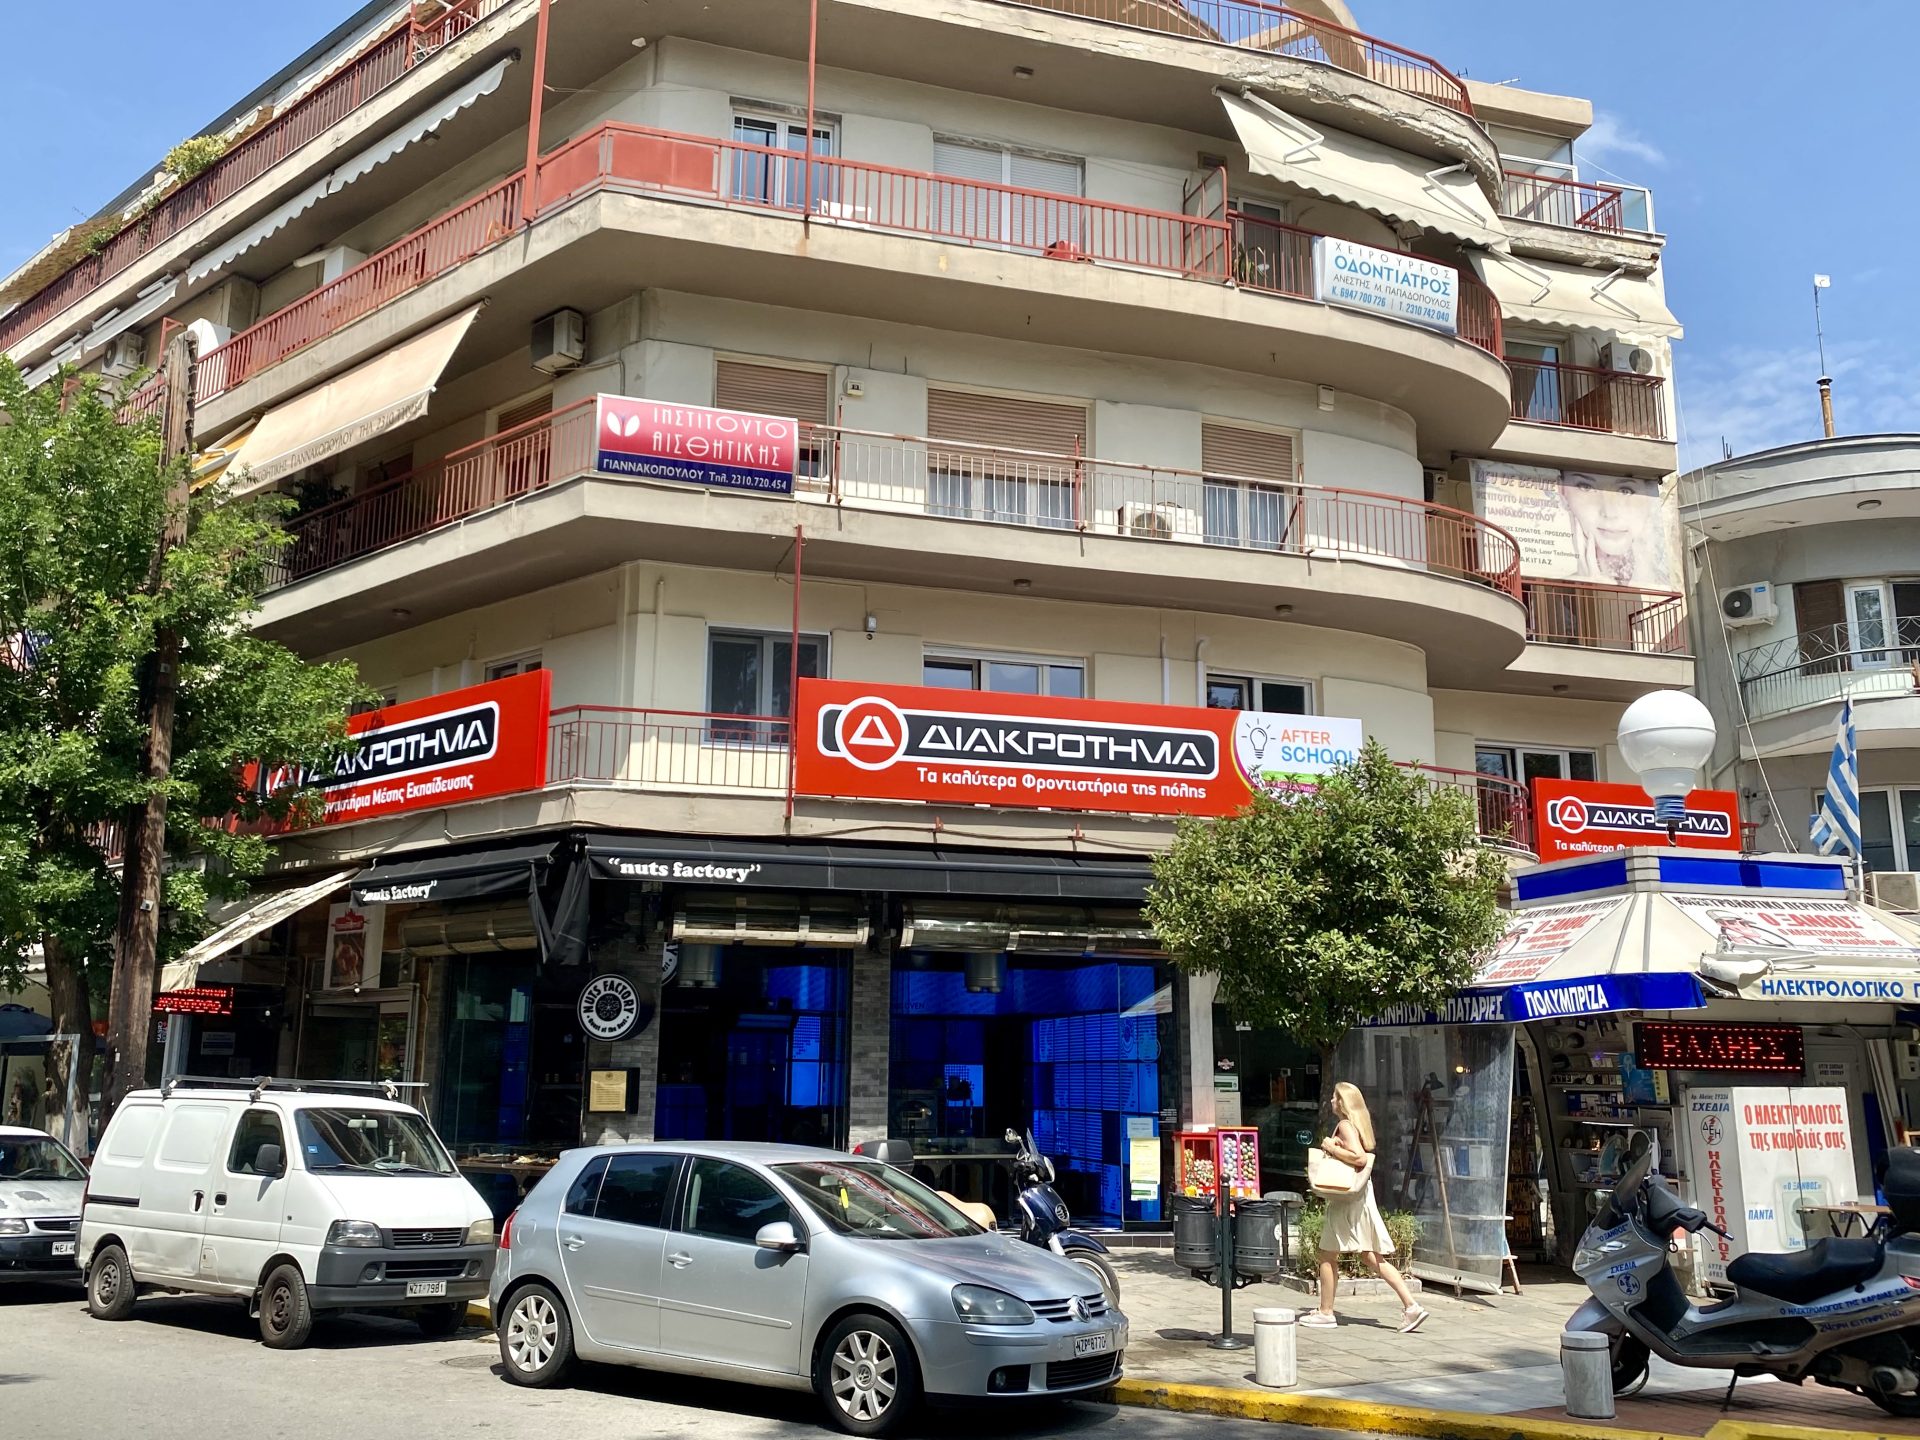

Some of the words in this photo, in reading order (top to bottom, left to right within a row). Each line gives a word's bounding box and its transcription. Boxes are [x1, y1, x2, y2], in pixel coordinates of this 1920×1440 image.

[1334, 255, 1451, 296] ΟΔΟΝΤΙΑΤΡΟΣ
[1335, 242, 1451, 279] ΧΕΙΡΟΥΡΓΟΣ
[1333, 274, 1370, 290] ΑΝΕΣΤΗΣ
[1385, 286, 1451, 310] ΠΑΠΑΔΟΠΟΥΛΟΣ
[1340, 288, 1358, 300] 6947
[1359, 290, 1373, 304] 700
[1373, 294, 1386, 307] 726
[1406, 303, 1422, 317] 2310
[1422, 306, 1436, 320] 742
[1436, 309, 1450, 322] 040
[653, 407, 788, 439] ΙΝΣΤΙΤΟΥΤΟ
[652, 431, 781, 467] ΑΙΣΘΗΤΙΚΗΣ
[602, 458, 704, 480] ΓΙΑΝΝΑΚΟΠΟΥΛΟΥ
[708, 471, 729, 484] Τηλ.
[731, 474, 787, 491] 2310.720.454
[918, 724, 1207, 768] ΔΙΑΚΡΟΤΗΜΑ
[1281, 728, 1331, 746] AFTER
[373, 787, 404, 803] Μέσης
[406, 774, 475, 799] Εκπαίδευσης
[916, 767, 937, 784] Τα
[942, 769, 1018, 791] καλύτερα
[1022, 774, 1128, 797] Φροντιστήρια
[1131, 781, 1157, 798] της
[1160, 782, 1208, 800] πόλης
[1554, 840, 1568, 851] Τα
[1569, 840, 1614, 853] καλύτερα
[1782, 900, 1859, 913] ΠΕΡΙΠΤΕΡΟ
[583, 985, 602, 1014] NUTS
[602, 980, 635, 1014] FACTORY
[1523, 984, 1609, 1017] ΠΟΛΥΜΠΡΙΖΑ
[1761, 979, 1904, 998] ΗΛΕΚΤΡΟΛΟΓΙΚΟ
[1692, 1102, 1730, 1112] ΣΧΕΔΙΑ
[1744, 1104, 1753, 1125] Ο
[1754, 1104, 1844, 1125] ΗΛΕΚΤΡΟΛΟΓΟΣ
[1702, 1121, 1721, 1139] ΔΕΗ
[1749, 1132, 1770, 1151] της
[1771, 1127, 1823, 1151] καρδιάς
[1824, 1131, 1846, 1150] σας
[1748, 1209, 1774, 1220] ΠΑΝΤΑ
[1610, 1260, 1637, 1274] ΣΧΕΔΙΑ
